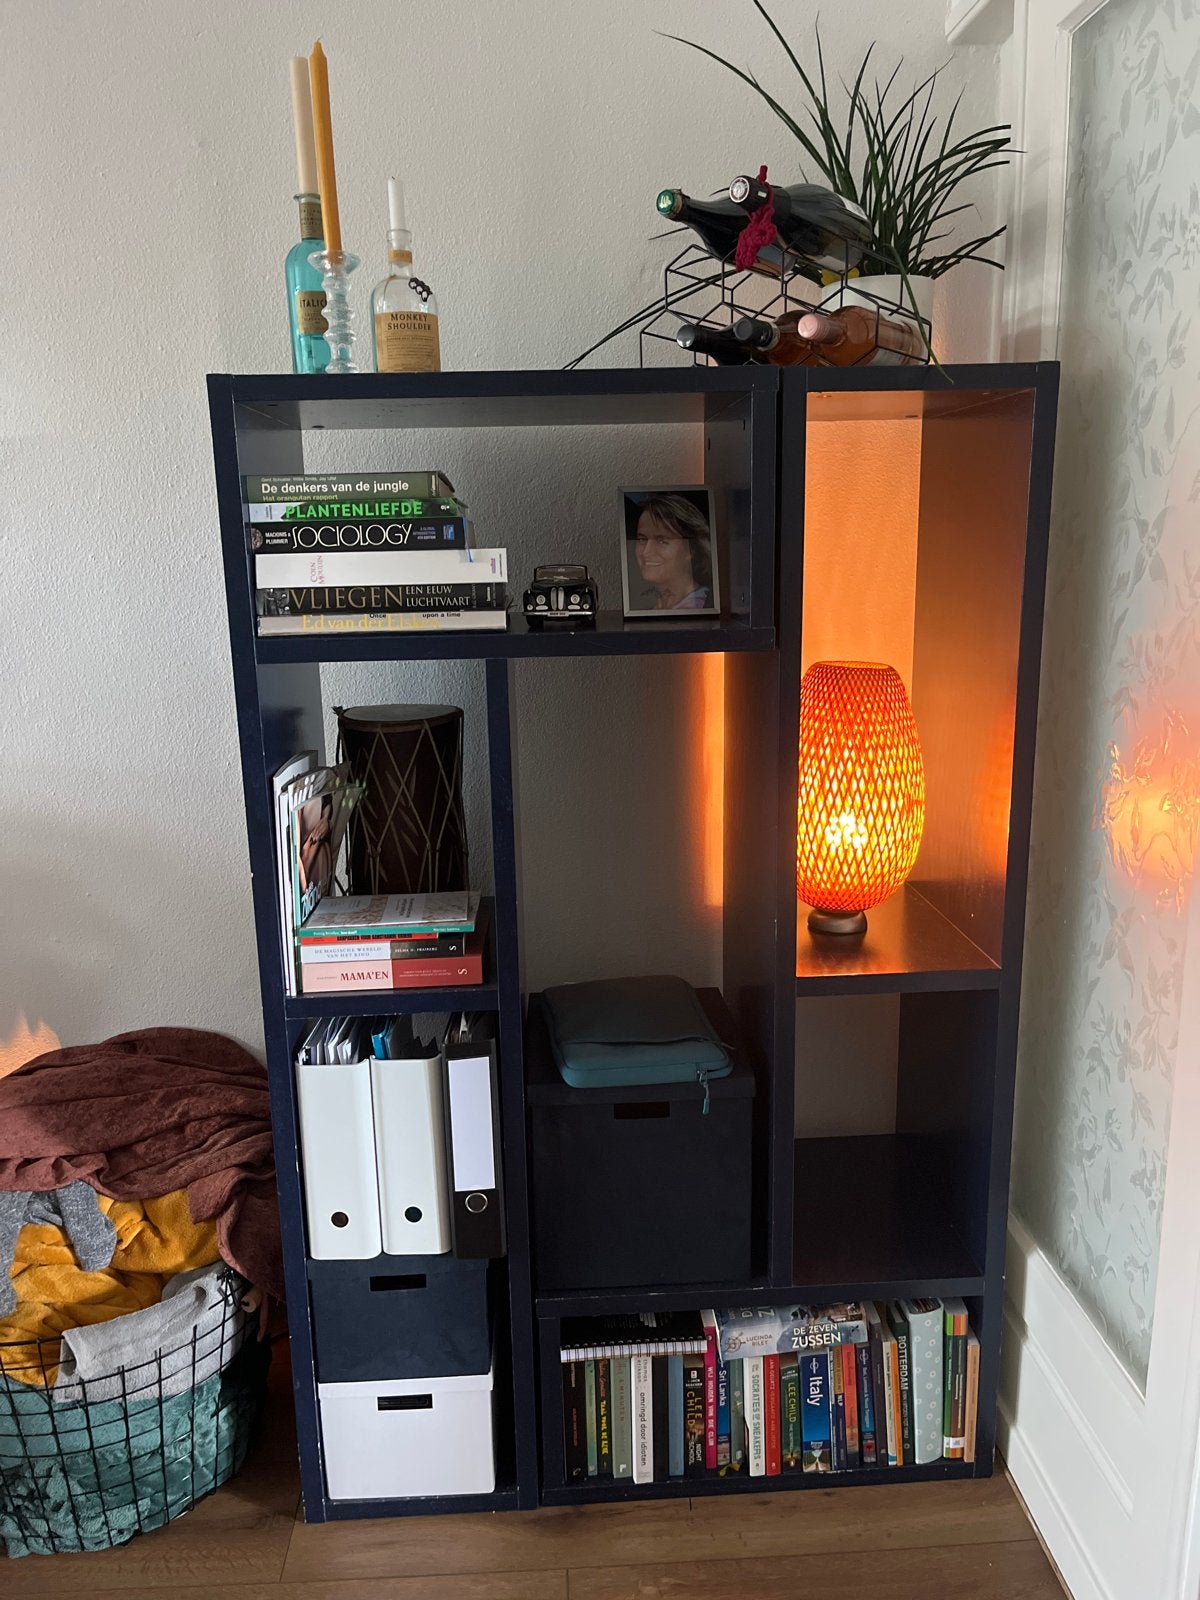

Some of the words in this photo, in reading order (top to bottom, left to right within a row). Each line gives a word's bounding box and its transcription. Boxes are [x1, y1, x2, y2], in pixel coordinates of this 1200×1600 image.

[390, 313, 428, 322] MONKEY
[261, 483, 278, 494] De
[281, 482, 328, 493] denkers
[331, 482, 352, 492] van
[356, 481, 370, 491] de
[373, 480, 409, 493] jungle
[286, 501, 423, 518] PLANTENLIEFDE
[292, 523, 412, 548] SOCIOLOGY
[288, 586, 403, 610] VLIEGEN
[405, 586, 423, 595] EEN
[425, 585, 453, 594] EEUW
[406, 595, 471, 607] LUCHTVAART
[302, 614, 325, 630] Ed
[327, 619, 354, 630] van
[358, 614, 383, 630] der
[339, 970, 389, 981] MAMA'EN
[746, 1334, 773, 1342] LUCINDA
[793, 1327, 806, 1336] DE
[809, 1323, 838, 1334] ZEVEN
[791, 1331, 842, 1349] ZUSSEN
[898, 1335, 909, 1390] ROTTERDAM
[719, 1370, 727, 1381] Sri
[719, 1383, 727, 1406] Lanka
[752, 1374, 760, 1413] SOCRATES
[788, 1382, 796, 1396] LEE
[807, 1376, 823, 1406] Italy
[639, 1392, 647, 1422] omringd
[687, 1390, 695, 1426] CHILD
[694, 1397, 703, 1419] LEE
[788, 1398, 797, 1423] CHILD
[753, 1421, 761, 1460] SNEAKERS
